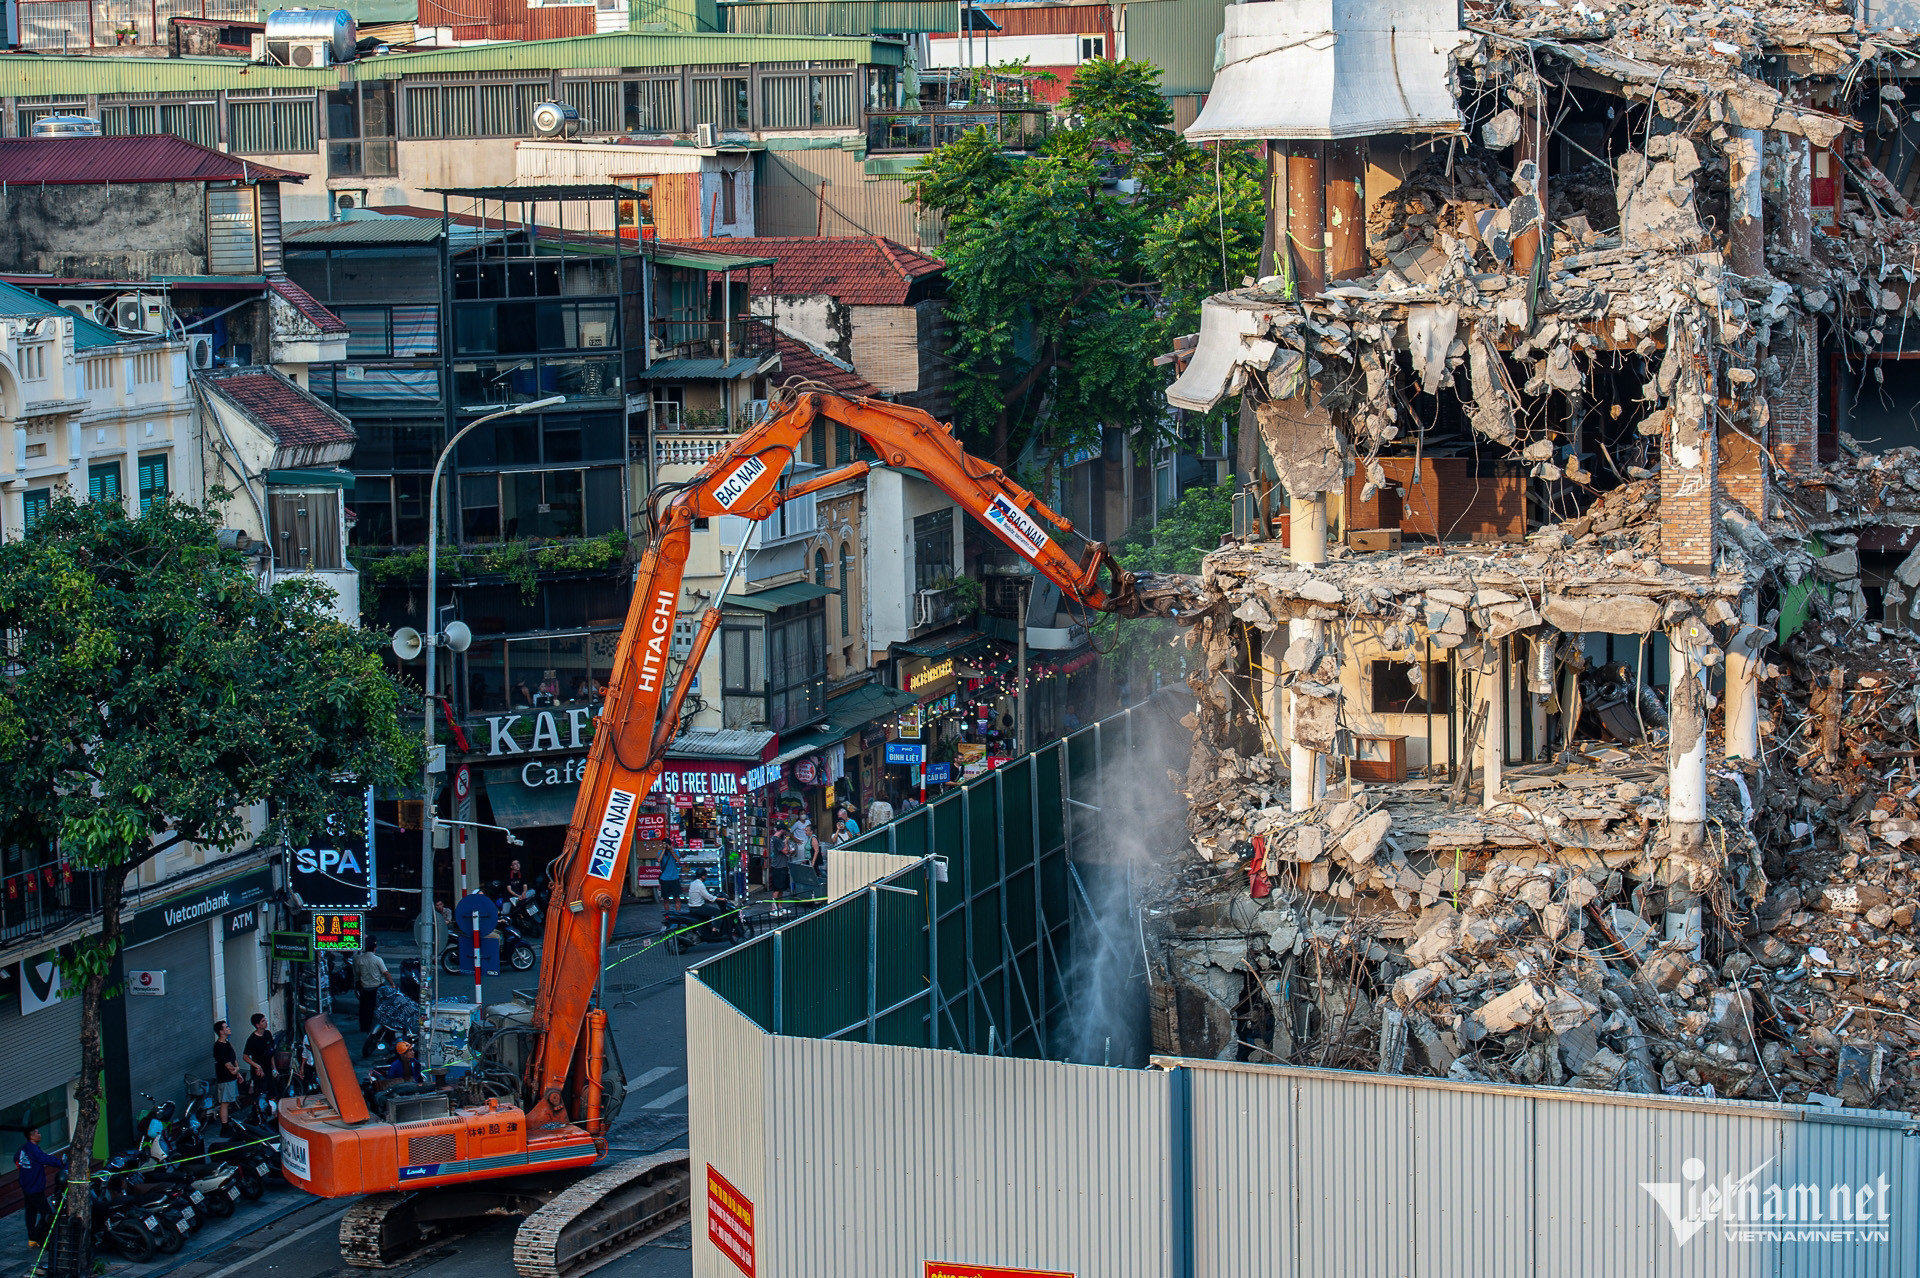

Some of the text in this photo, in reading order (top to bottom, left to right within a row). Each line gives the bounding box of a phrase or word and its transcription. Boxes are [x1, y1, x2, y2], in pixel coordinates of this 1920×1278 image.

[716, 457, 764, 506] BAC NAM
[1007, 511, 1045, 548] BAC NAM
[638, 590, 674, 692] HITACHI
[485, 707, 604, 756] KAF
[521, 758, 587, 788] Café
[665, 772, 679, 793] 5G
[682, 772, 708, 794] FREE
[711, 772, 738, 794] DATA
[596, 791, 632, 859] BAC NAM
[637, 816, 664, 825] VELO
[296, 849, 362, 875] SPA
[164, 890, 230, 926] Vietcombank
[232, 911, 254, 931] ATM
[317, 941, 359, 949] SHAMPOO
